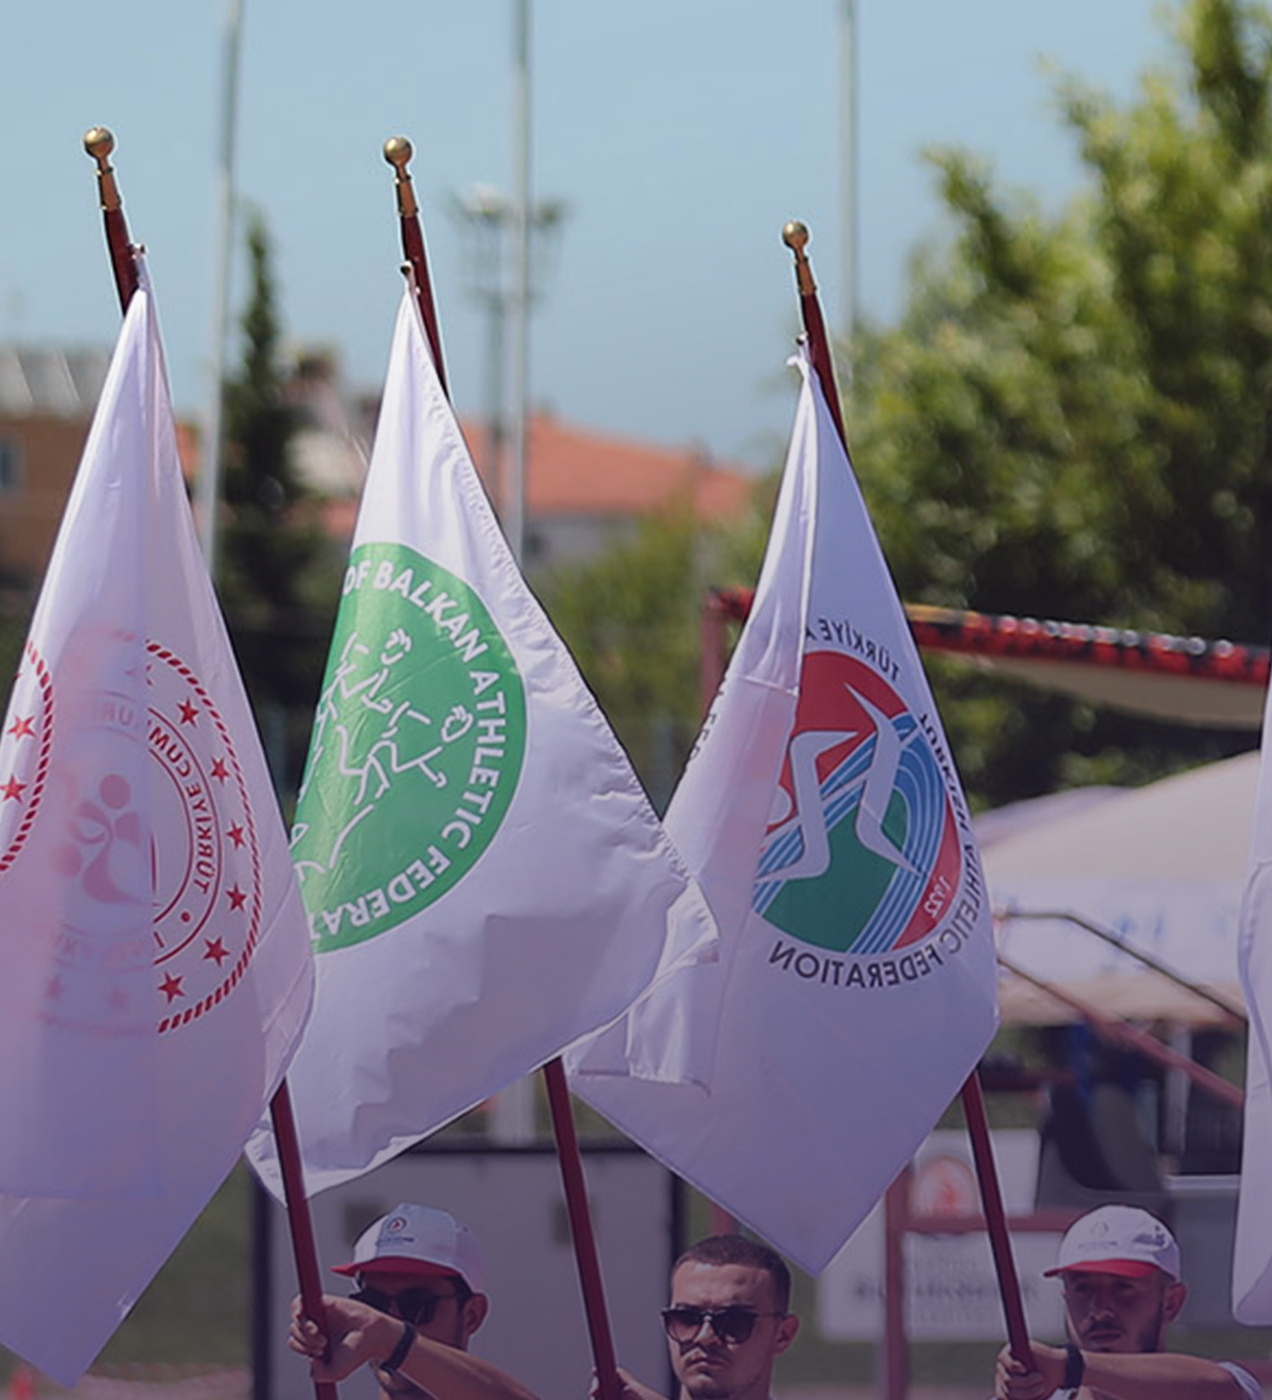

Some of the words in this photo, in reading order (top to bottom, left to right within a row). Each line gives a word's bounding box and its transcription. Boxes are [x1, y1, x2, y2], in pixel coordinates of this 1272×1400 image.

[373, 560, 489, 662] BALKAN
[442, 668, 507, 849] ATHLETIC
[308, 844, 452, 940] FEDERAT
